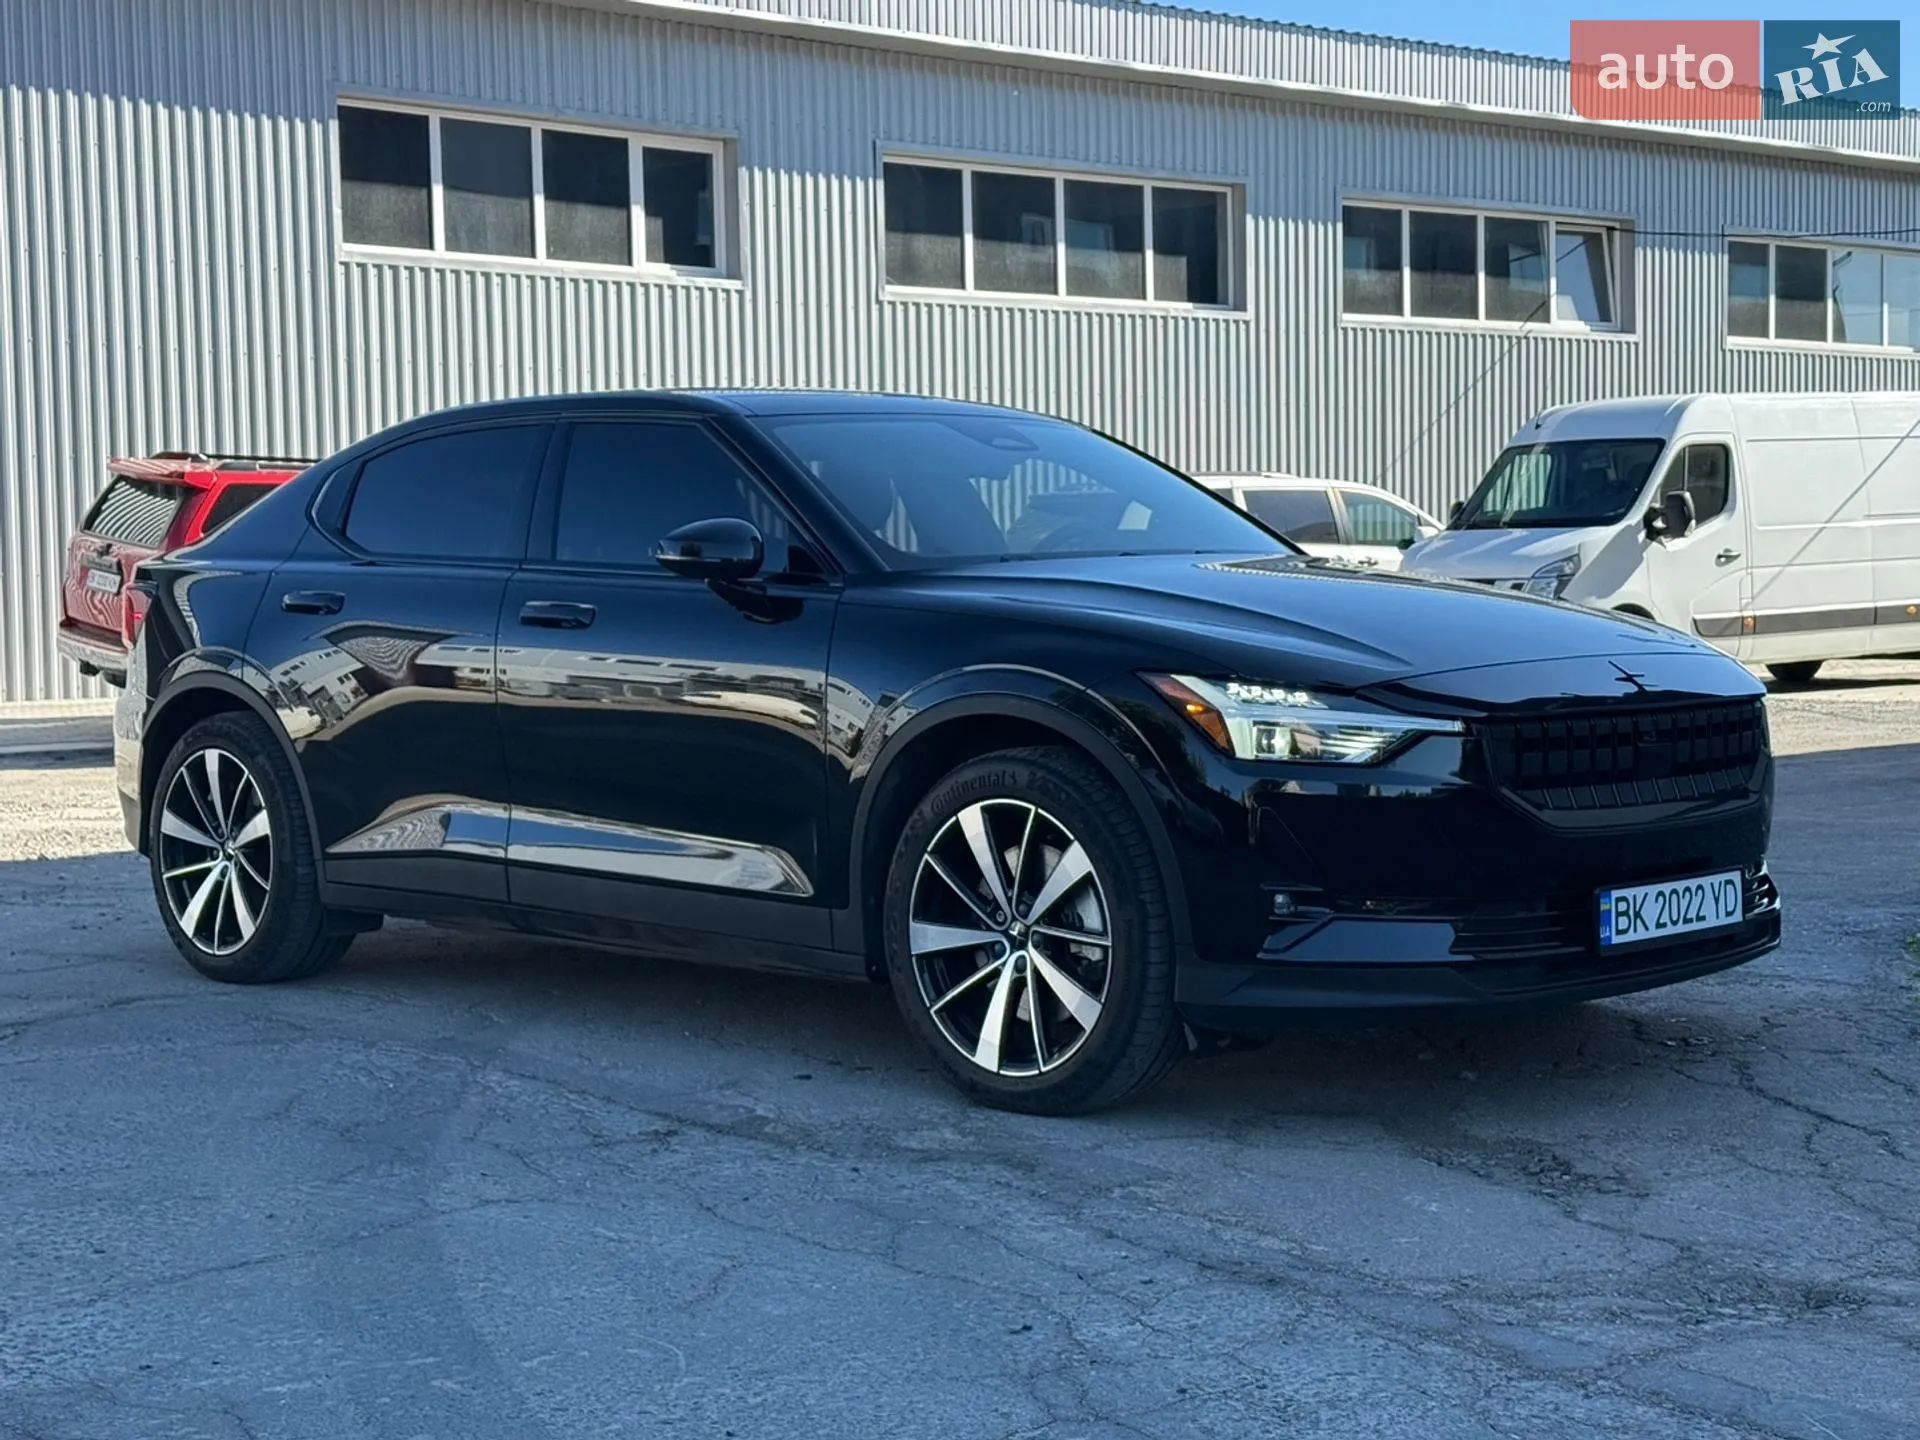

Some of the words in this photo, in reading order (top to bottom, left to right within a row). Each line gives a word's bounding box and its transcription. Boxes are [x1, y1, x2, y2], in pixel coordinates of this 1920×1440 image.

[930, 769, 1007, 817] Continental
[1615, 892, 1650, 936] BK
[1655, 883, 1707, 930] 2022
[1710, 878, 1738, 920] YD
